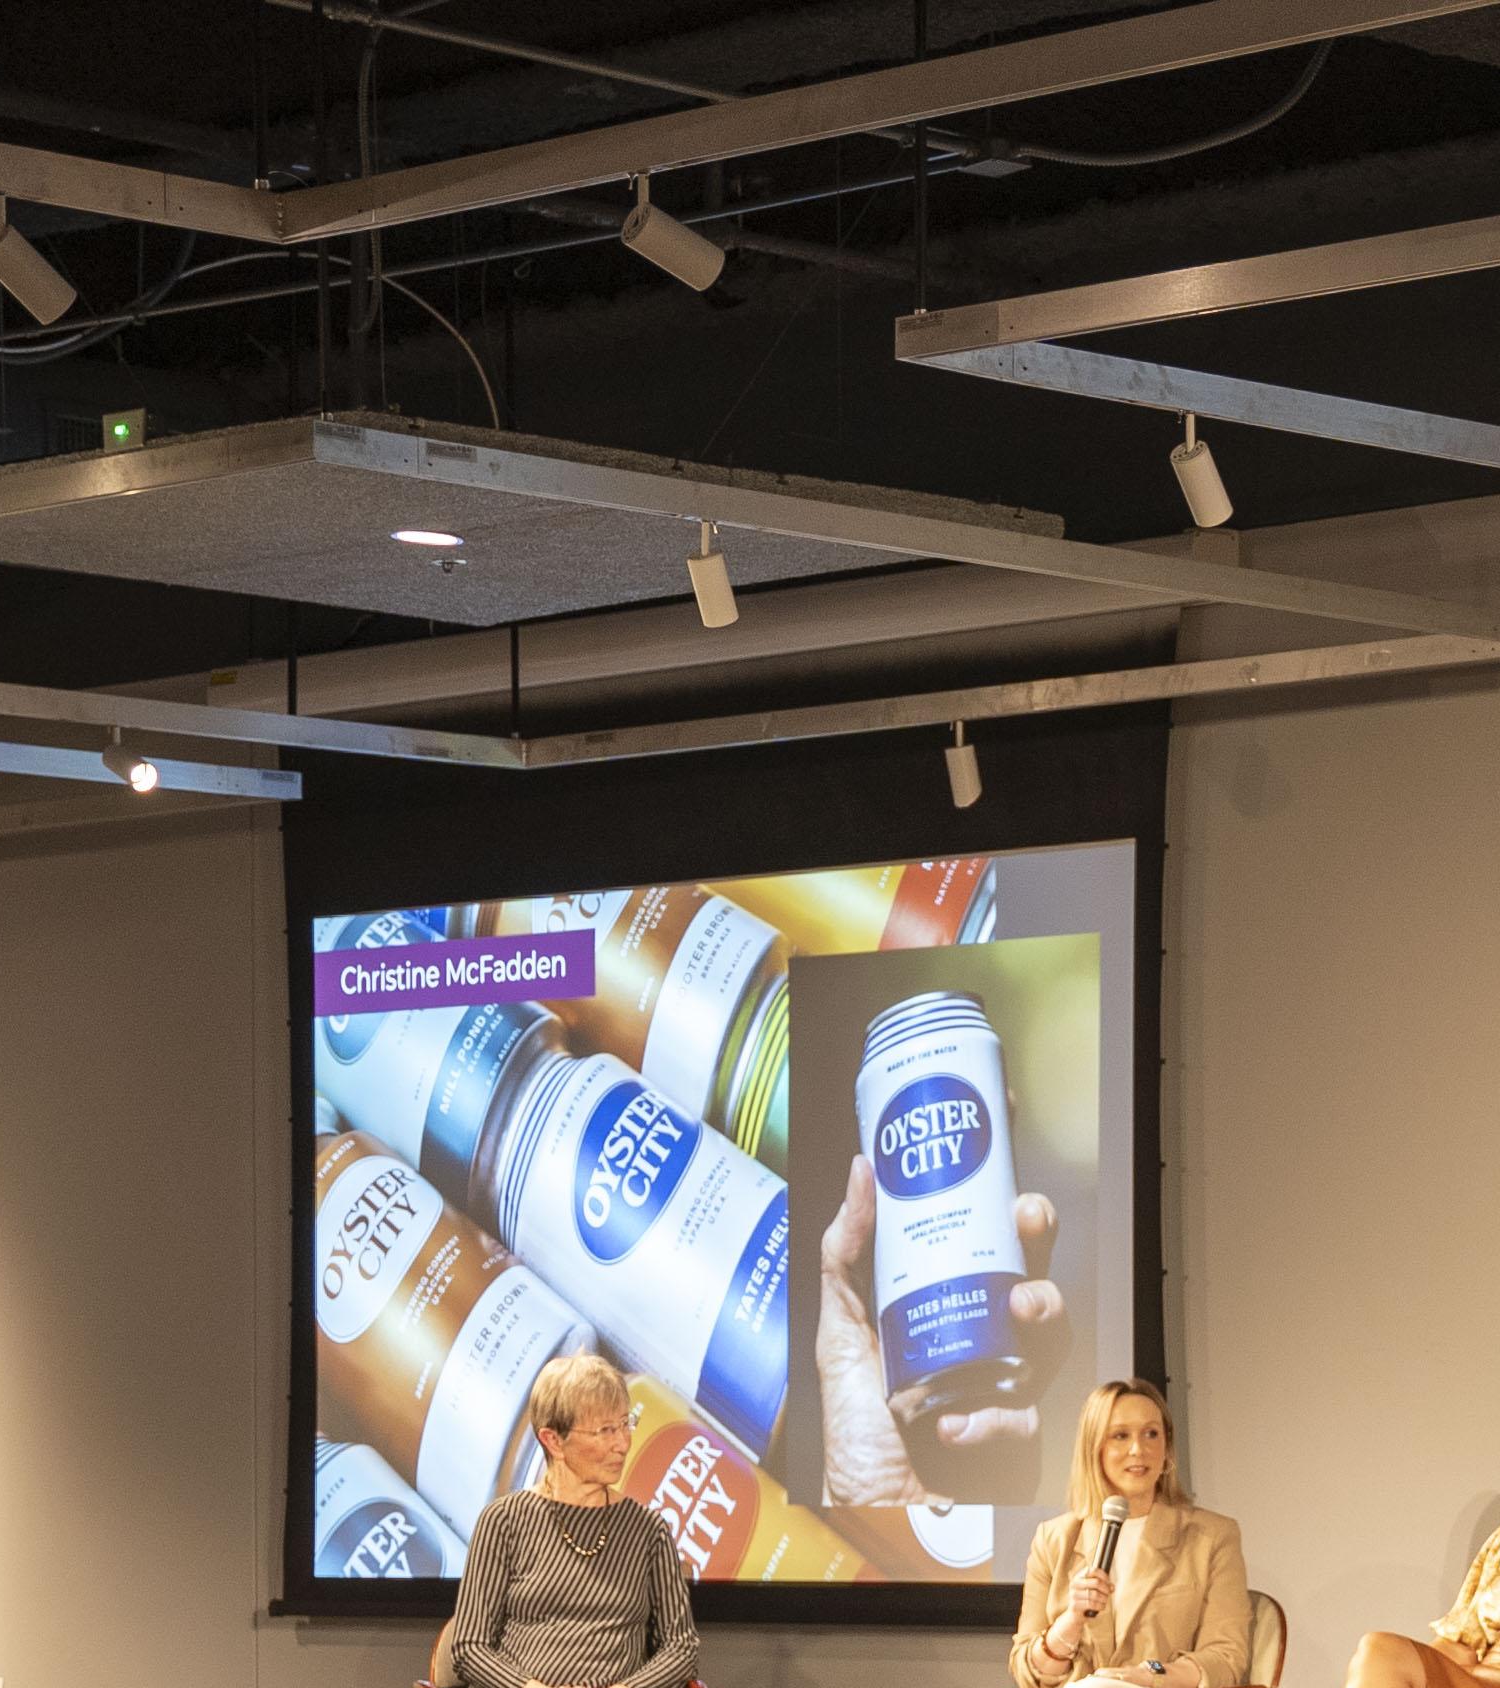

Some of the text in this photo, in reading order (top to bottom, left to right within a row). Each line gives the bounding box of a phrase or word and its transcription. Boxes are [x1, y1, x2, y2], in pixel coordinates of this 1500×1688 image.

[340, 949, 567, 995] Christine McFadden
[457, 1015, 486, 1062] POND
[880, 1100, 981, 1156] OYSTER
[900, 1133, 964, 1179] CITY
[621, 1113, 684, 1209] CITY
[322, 1167, 416, 1300] OYSTER
[358, 1193, 419, 1280] CITY
[490, 1282, 529, 1323] BROWN
[733, 1255, 772, 1321] TATES
[906, 1288, 988, 1323] TATES HELLES
[342, 1511, 419, 1578] TER
[677, 1474, 737, 1582] ITY
